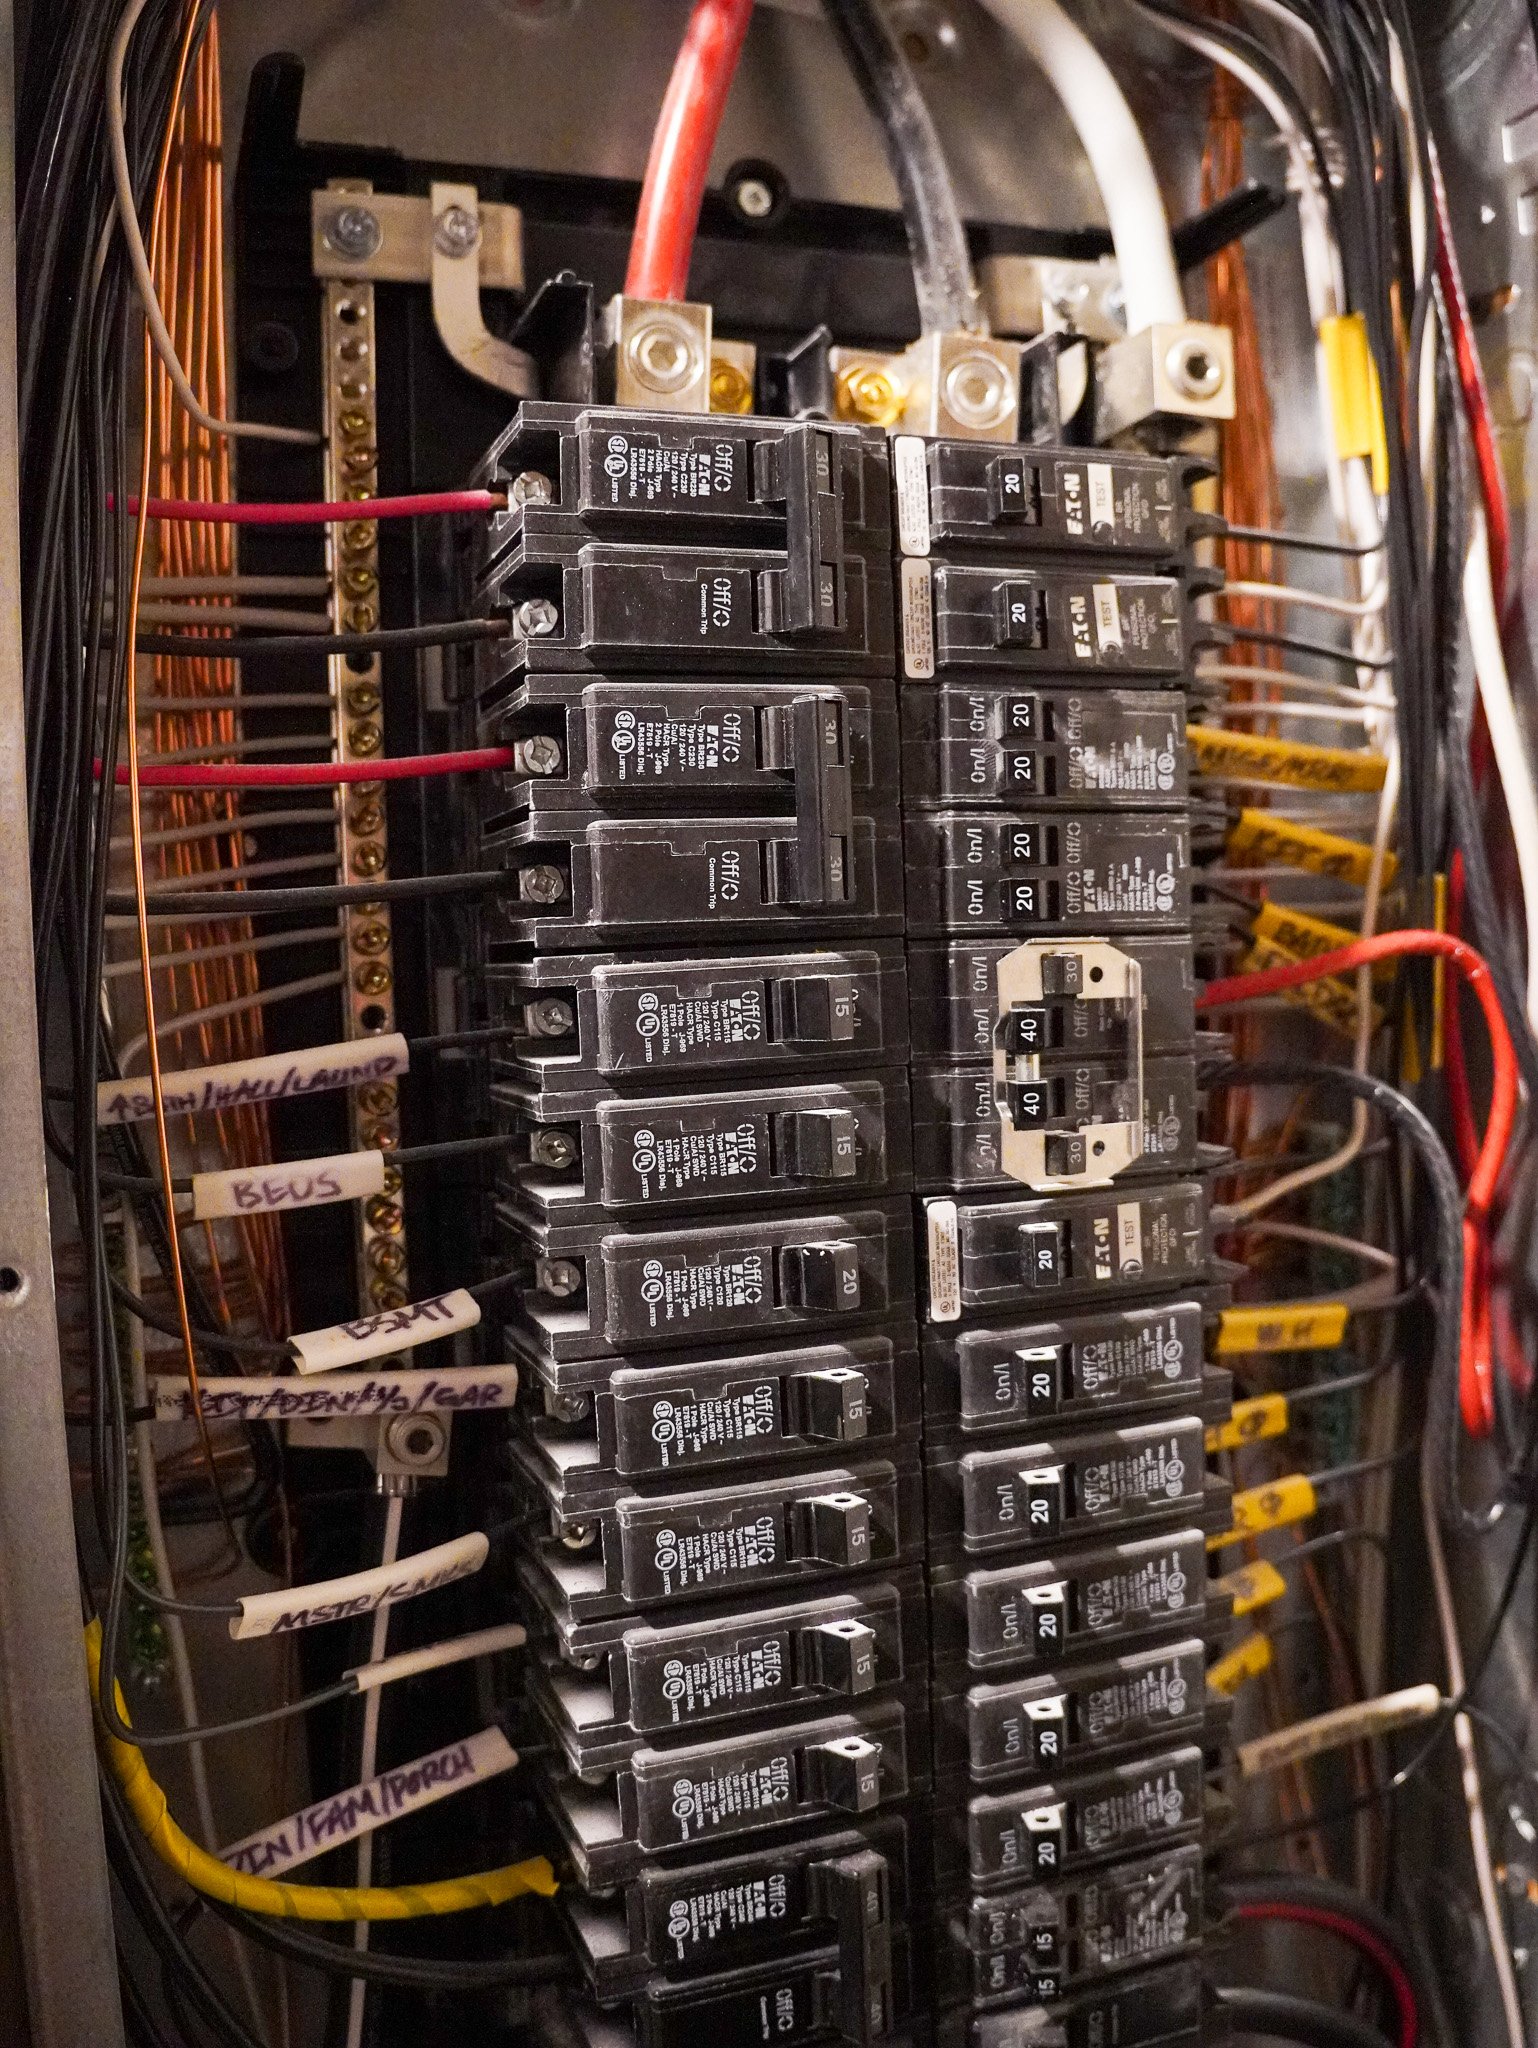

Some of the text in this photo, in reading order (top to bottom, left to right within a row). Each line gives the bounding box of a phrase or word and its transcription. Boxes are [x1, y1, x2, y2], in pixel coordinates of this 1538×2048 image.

[815, 449, 829, 477] 30
[1005, 473, 1020, 494] 20
[1095, 481, 1105, 507] TEST
[820, 581, 834, 608] 30
[700, 584, 708, 634] Common Trip
[1012, 603, 1026, 623] 20
[1101, 601, 1112, 627] TEST
[1013, 703, 1029, 727] 20
[824, 718, 837, 745] 30
[688, 724, 696, 766] Type C230
[1014, 756, 1031, 779] 20
[1014, 833, 1030, 857] 20
[830, 856, 842, 882] 30
[708, 894, 716, 909] Trip
[1016, 886, 1032, 911] 20
[1066, 961, 1078, 982] 30
[712, 1000, 720, 1019] Type
[835, 996, 850, 1018] 15
[721, 999, 731, 1043] Type BR115
[1020, 1018, 1037, 1042] 40
[1023, 1092, 1040, 1115] 40
[716, 1133, 724, 1151] Type
[836, 1135, 852, 1156] 15
[1070, 1141, 1081, 1162] 30
[707, 1134, 717, 1174] Type C115
[641, 1174, 649, 1198] LISTED
[1124, 1219, 1135, 1246] TEST
[1039, 1250, 1052, 1269] 20
[842, 1268, 857, 1295] 20
[1033, 1373, 1050, 1397] 20
[849, 1398, 863, 1419] 15
[1031, 1500, 1049, 1523] 20
[851, 1525, 865, 1547] 15
[1040, 1613, 1056, 1637] 20
[856, 1653, 870, 1675] 15
[1040, 1731, 1057, 1756] 20
[861, 1772, 875, 1794] 15
[1038, 1842, 1055, 1865] 20
[1037, 1933, 1053, 1950] 15
[1038, 1979, 1055, 1995] 15
